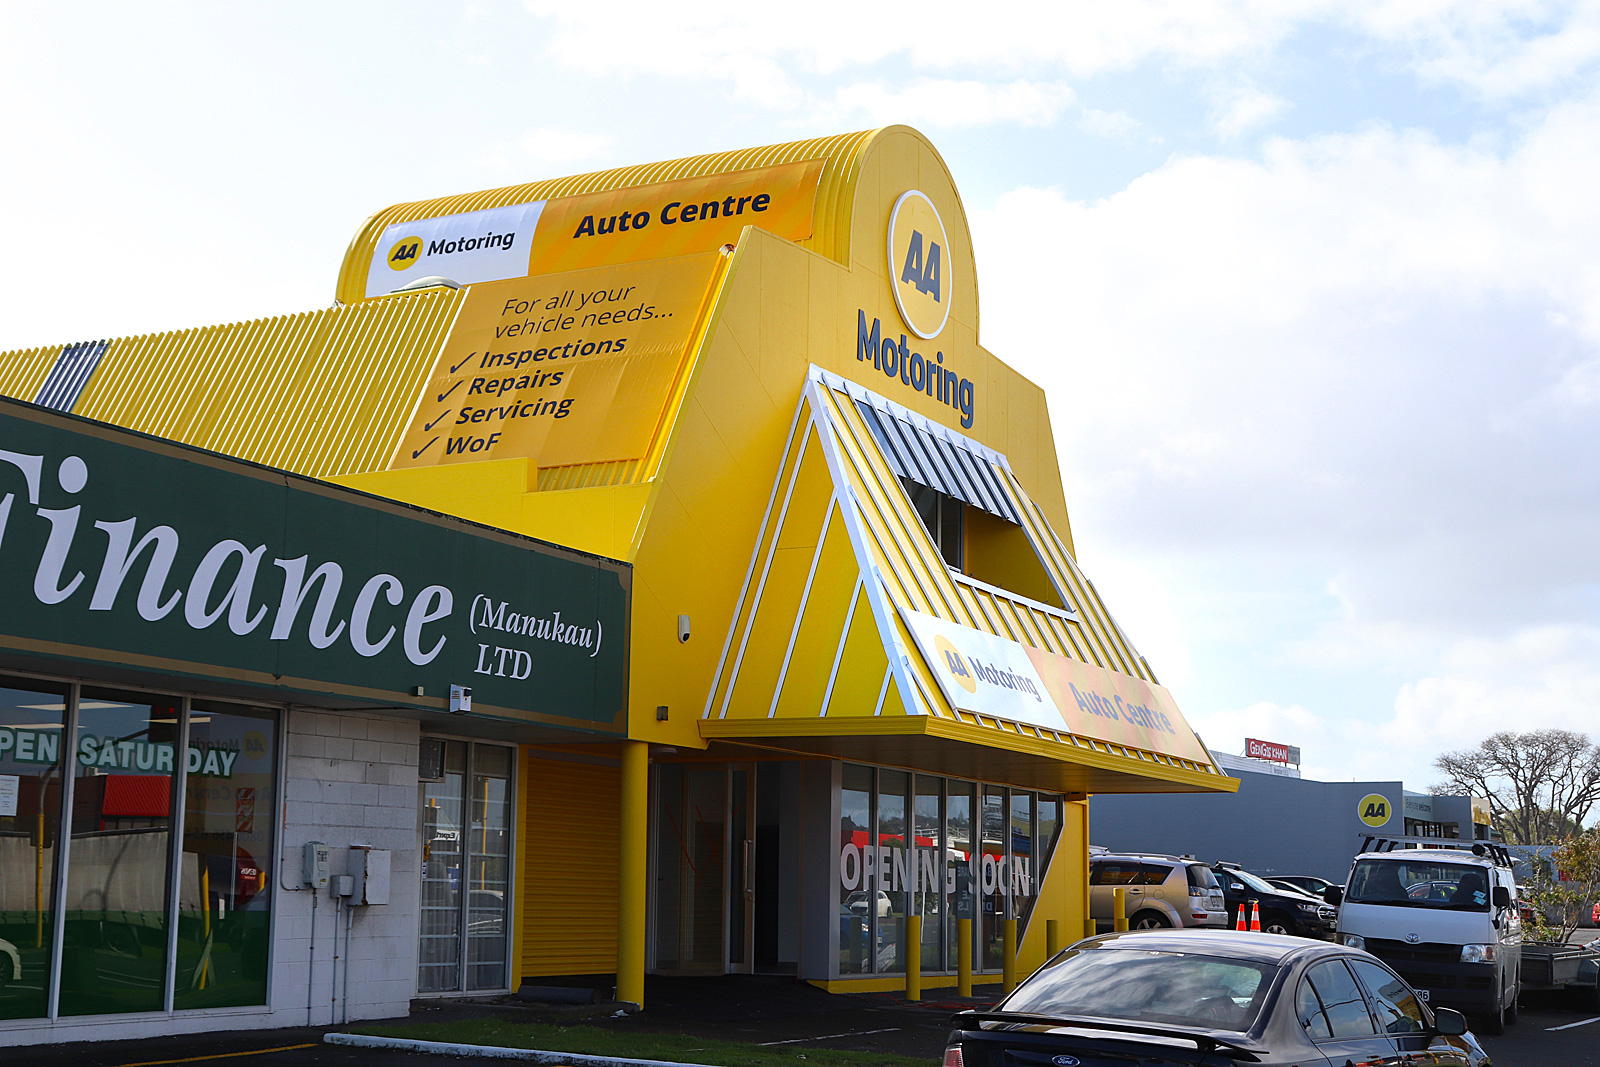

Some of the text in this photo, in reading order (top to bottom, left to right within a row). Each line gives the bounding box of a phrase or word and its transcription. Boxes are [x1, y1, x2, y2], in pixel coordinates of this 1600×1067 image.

[391, 192, 771, 262] AA Motoring Auto Centre
[901, 229, 940, 303] AA
[502, 286, 636, 316] For all your
[495, 303, 673, 339] vehicle needs...
[479, 338, 627, 369] Inspections
[857, 308, 974, 429] Motoring
[468, 369, 564, 397] Repairs
[455, 398, 575, 425] Servicing
[445, 432, 502, 456] WoF
[469, 593, 602, 658] (Manukau)
[474, 643, 532, 680] LTD
[944, 650, 1175, 735] AA Motoring Auto Centre
[79, 737, 238, 777] SATURDAY
[1363, 803, 1385, 817] AA
[840, 843, 956, 893] OPENING
